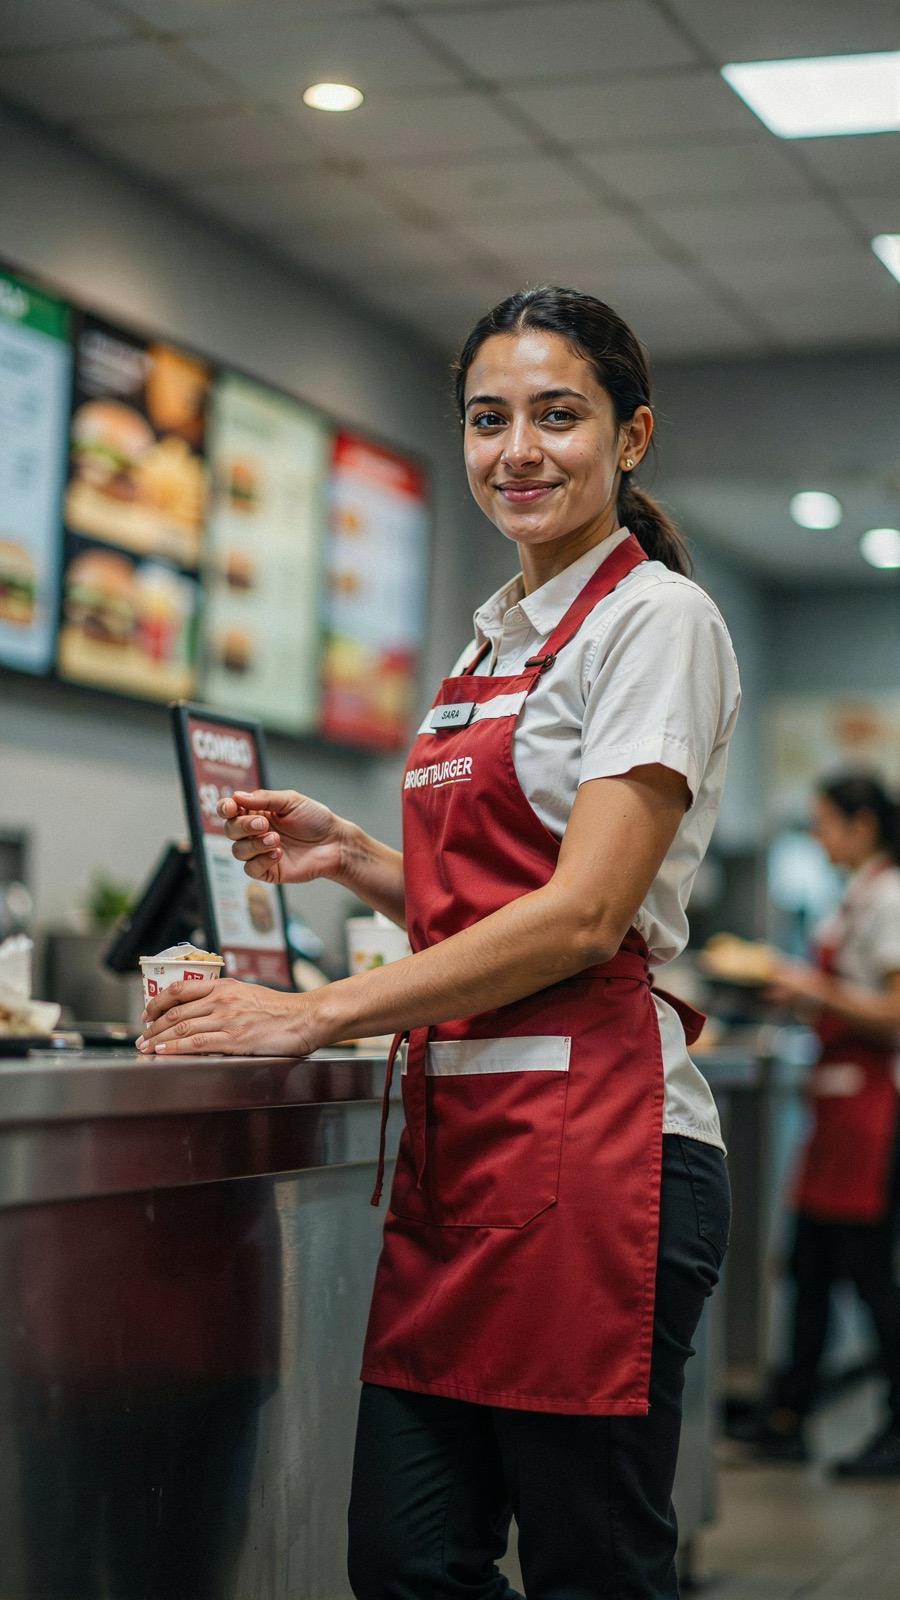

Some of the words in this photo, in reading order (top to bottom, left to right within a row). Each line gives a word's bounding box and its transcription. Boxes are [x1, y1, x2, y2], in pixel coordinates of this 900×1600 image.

[441, 709, 460, 720] SARA
[192, 728, 252, 769] COMBO
[404, 757, 472, 790] BRIGHTBURGER
